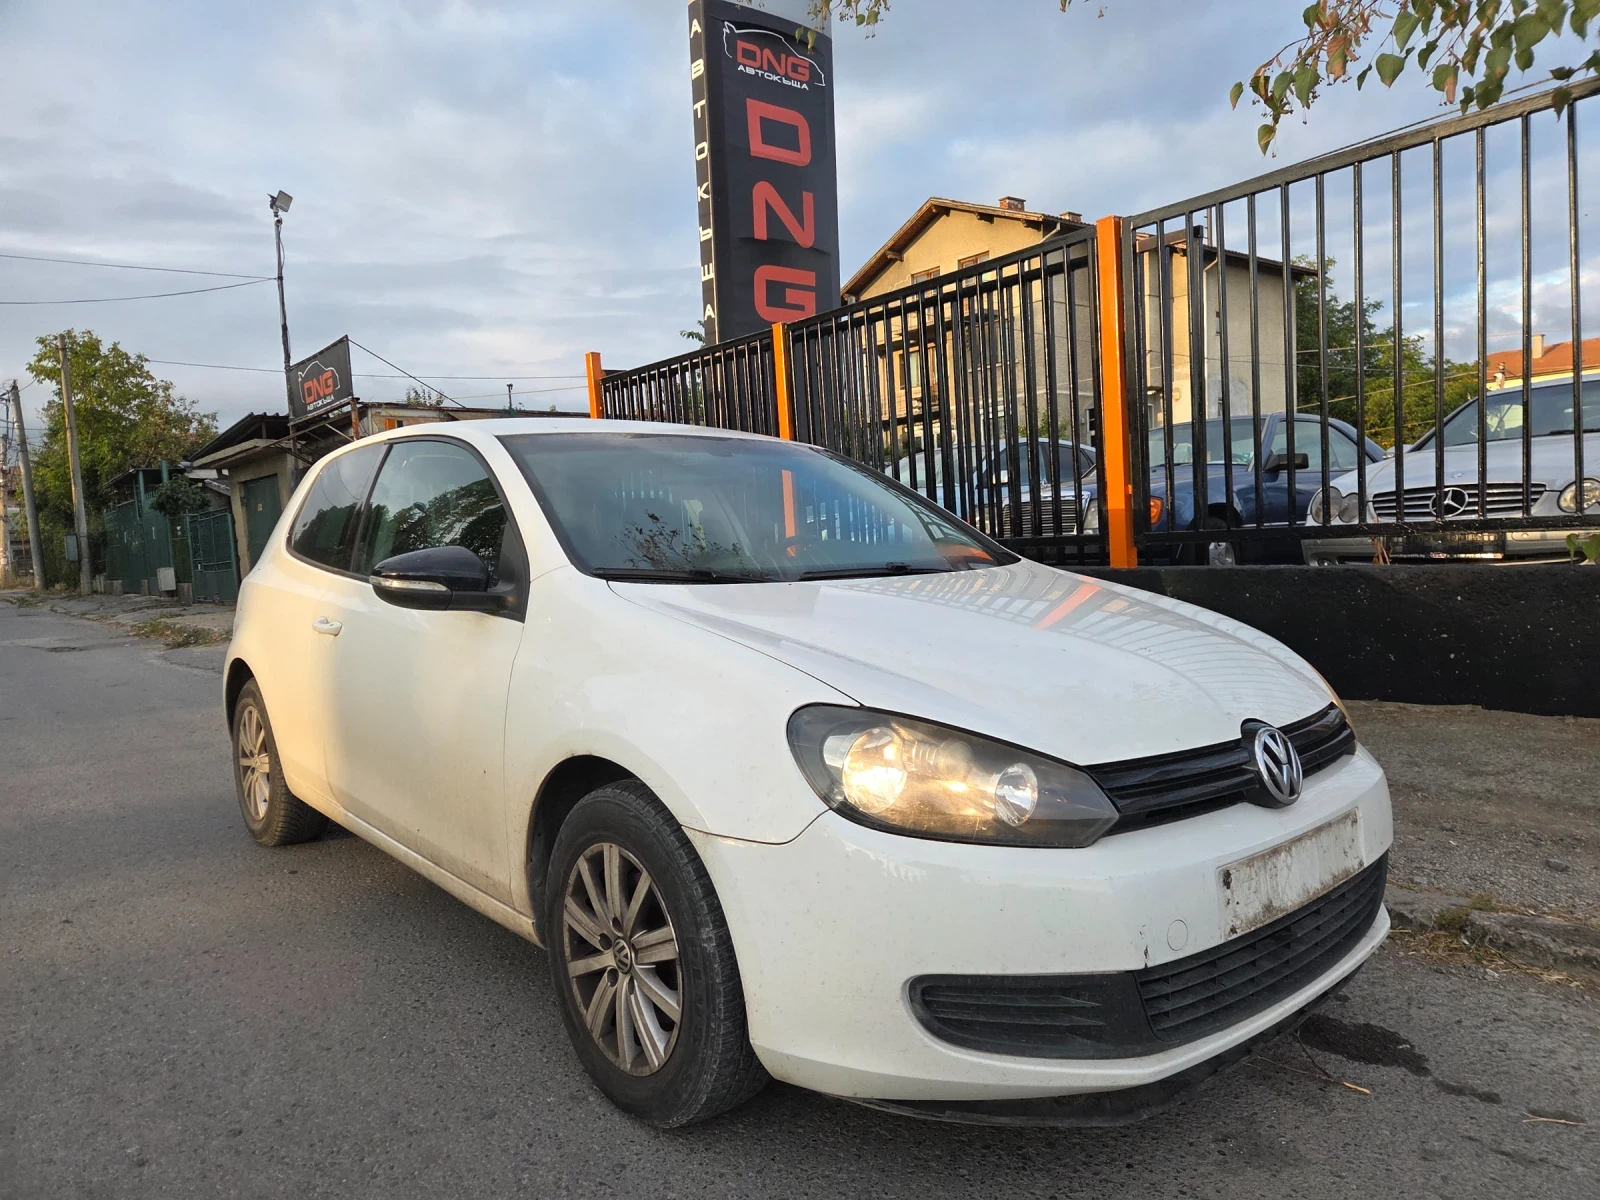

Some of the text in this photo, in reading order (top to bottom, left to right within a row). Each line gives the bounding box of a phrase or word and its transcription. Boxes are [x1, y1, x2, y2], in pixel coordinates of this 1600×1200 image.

[736, 40, 810, 82] DNG
[746, 97, 816, 323] DNG
[303, 369, 334, 404] DNG
